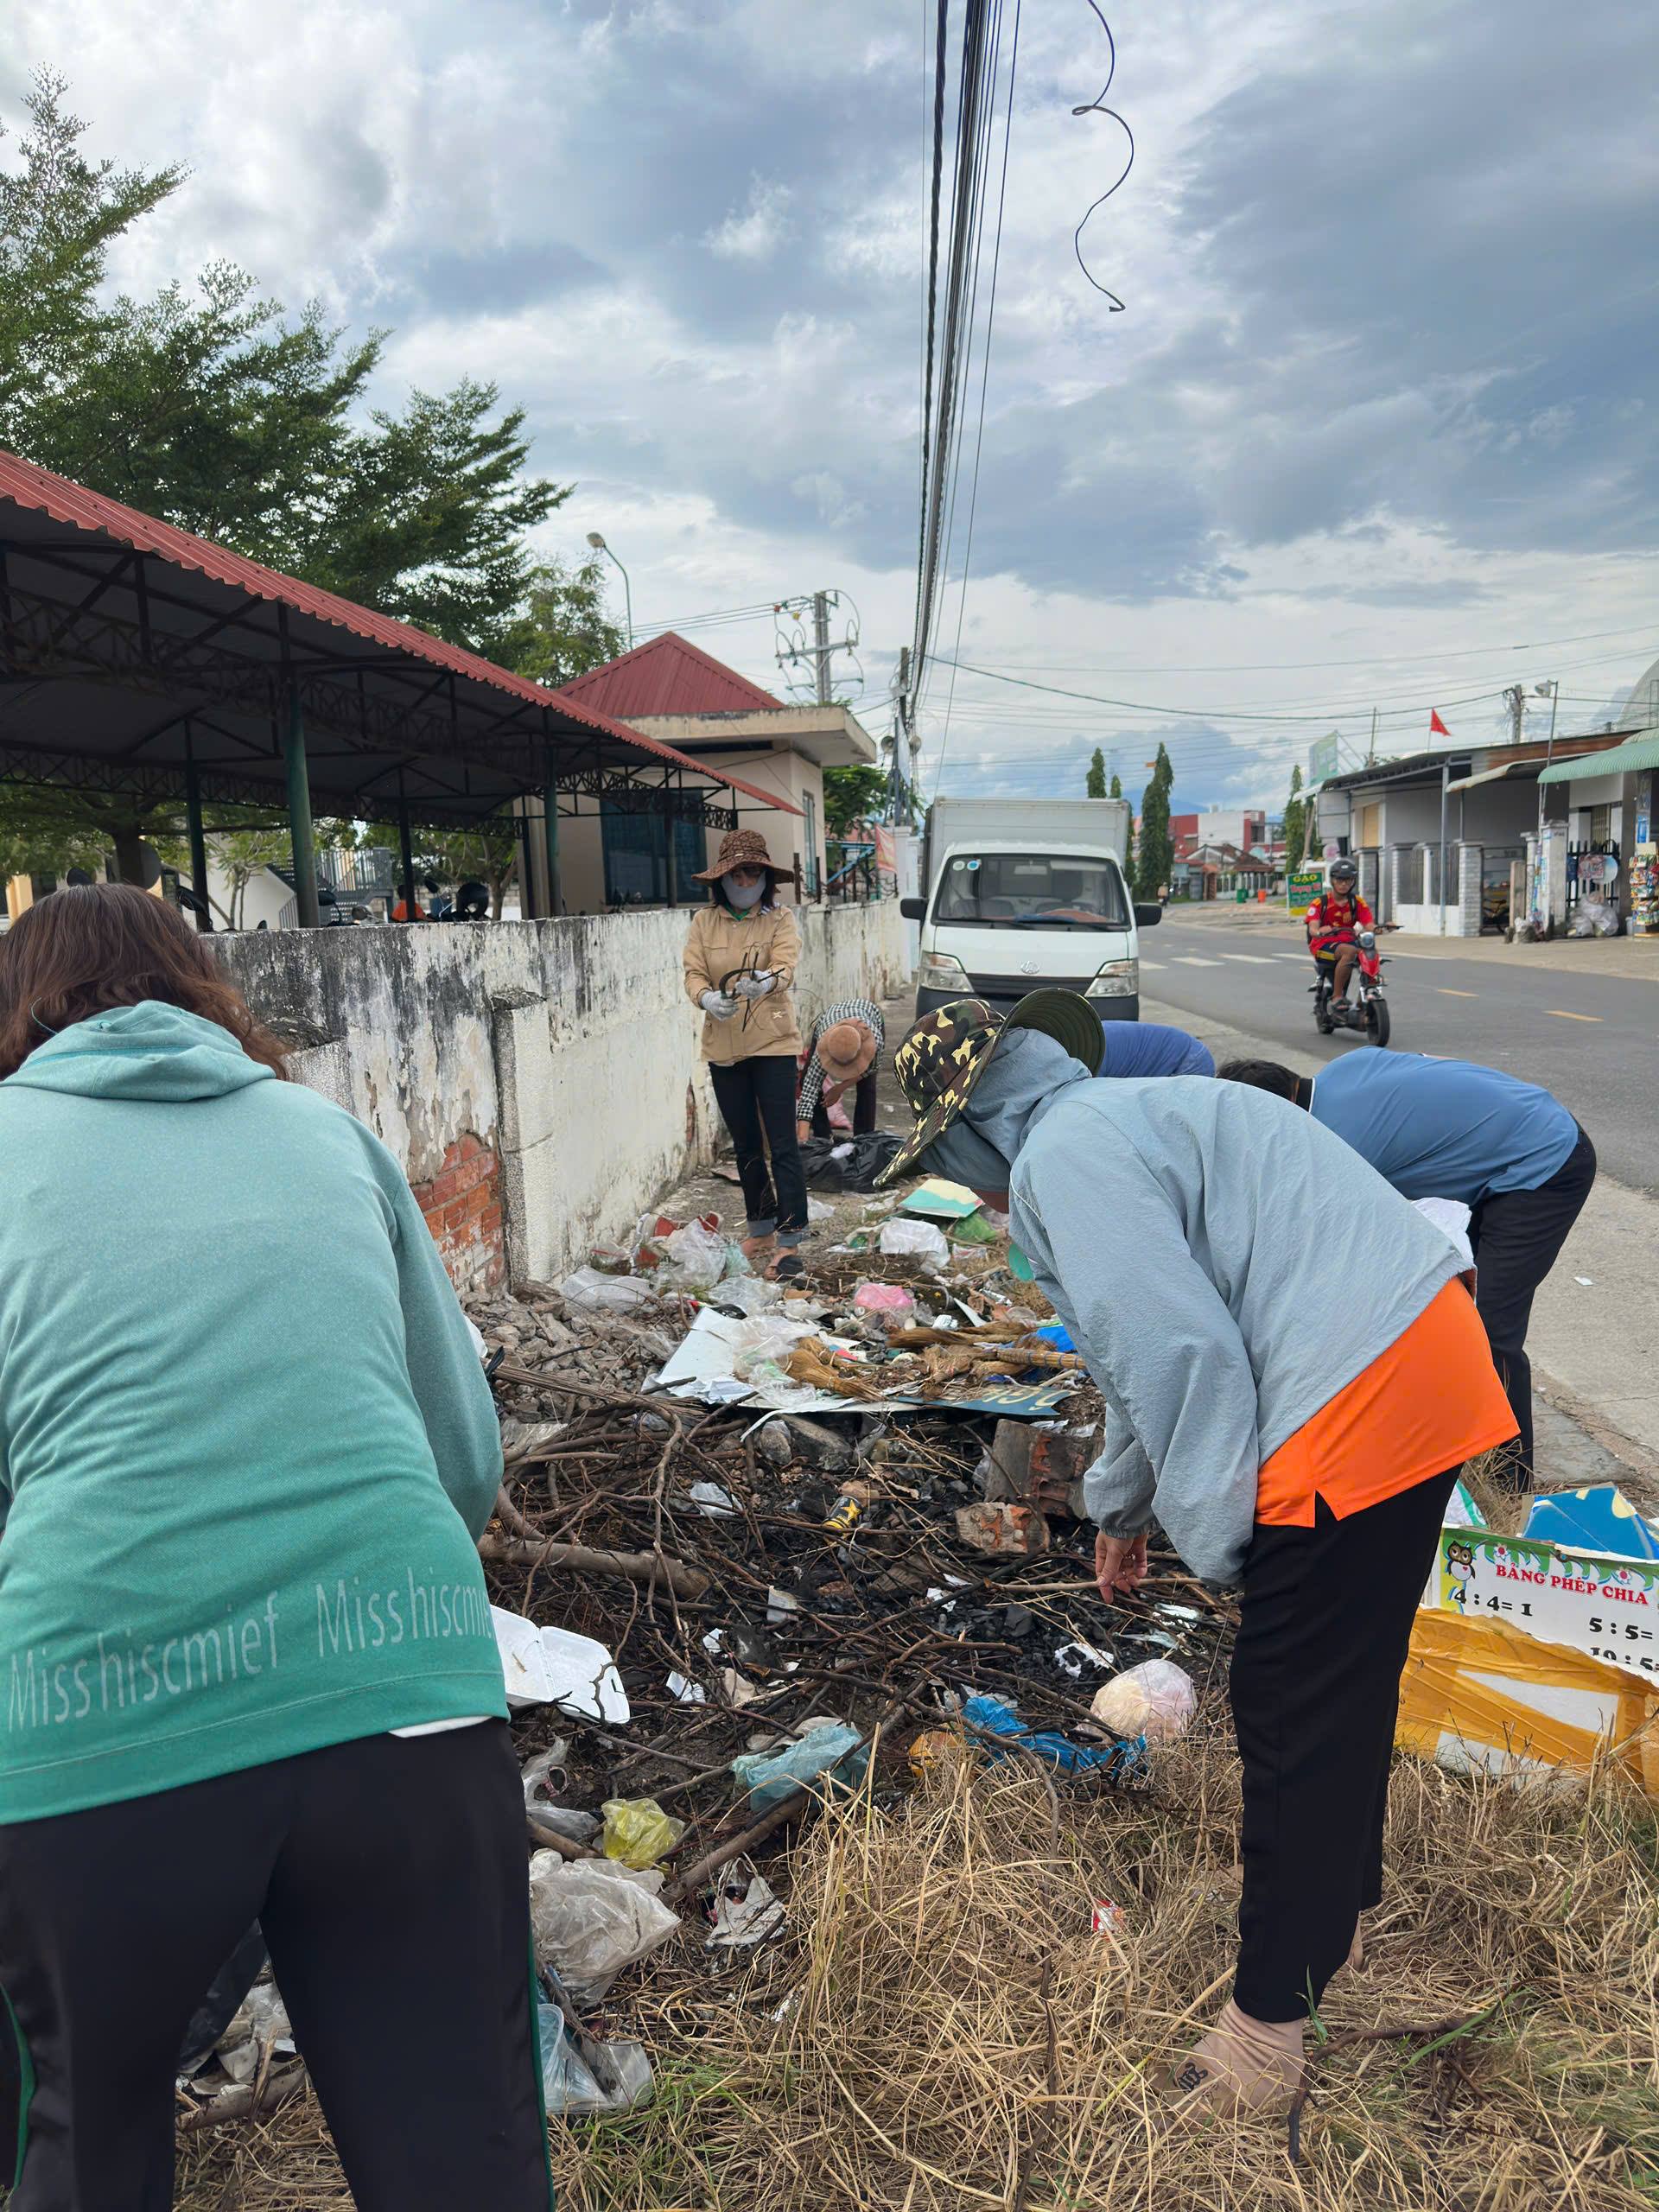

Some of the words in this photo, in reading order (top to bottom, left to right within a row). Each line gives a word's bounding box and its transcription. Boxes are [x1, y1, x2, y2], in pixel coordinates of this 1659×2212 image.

[1496, 1562, 1546, 1585] BẢNG
[1551, 1575, 1597, 1595] PHÉP
[1602, 1586, 1648, 1605] CHIA
[8, 1591, 279, 1732] Misshiscmief
